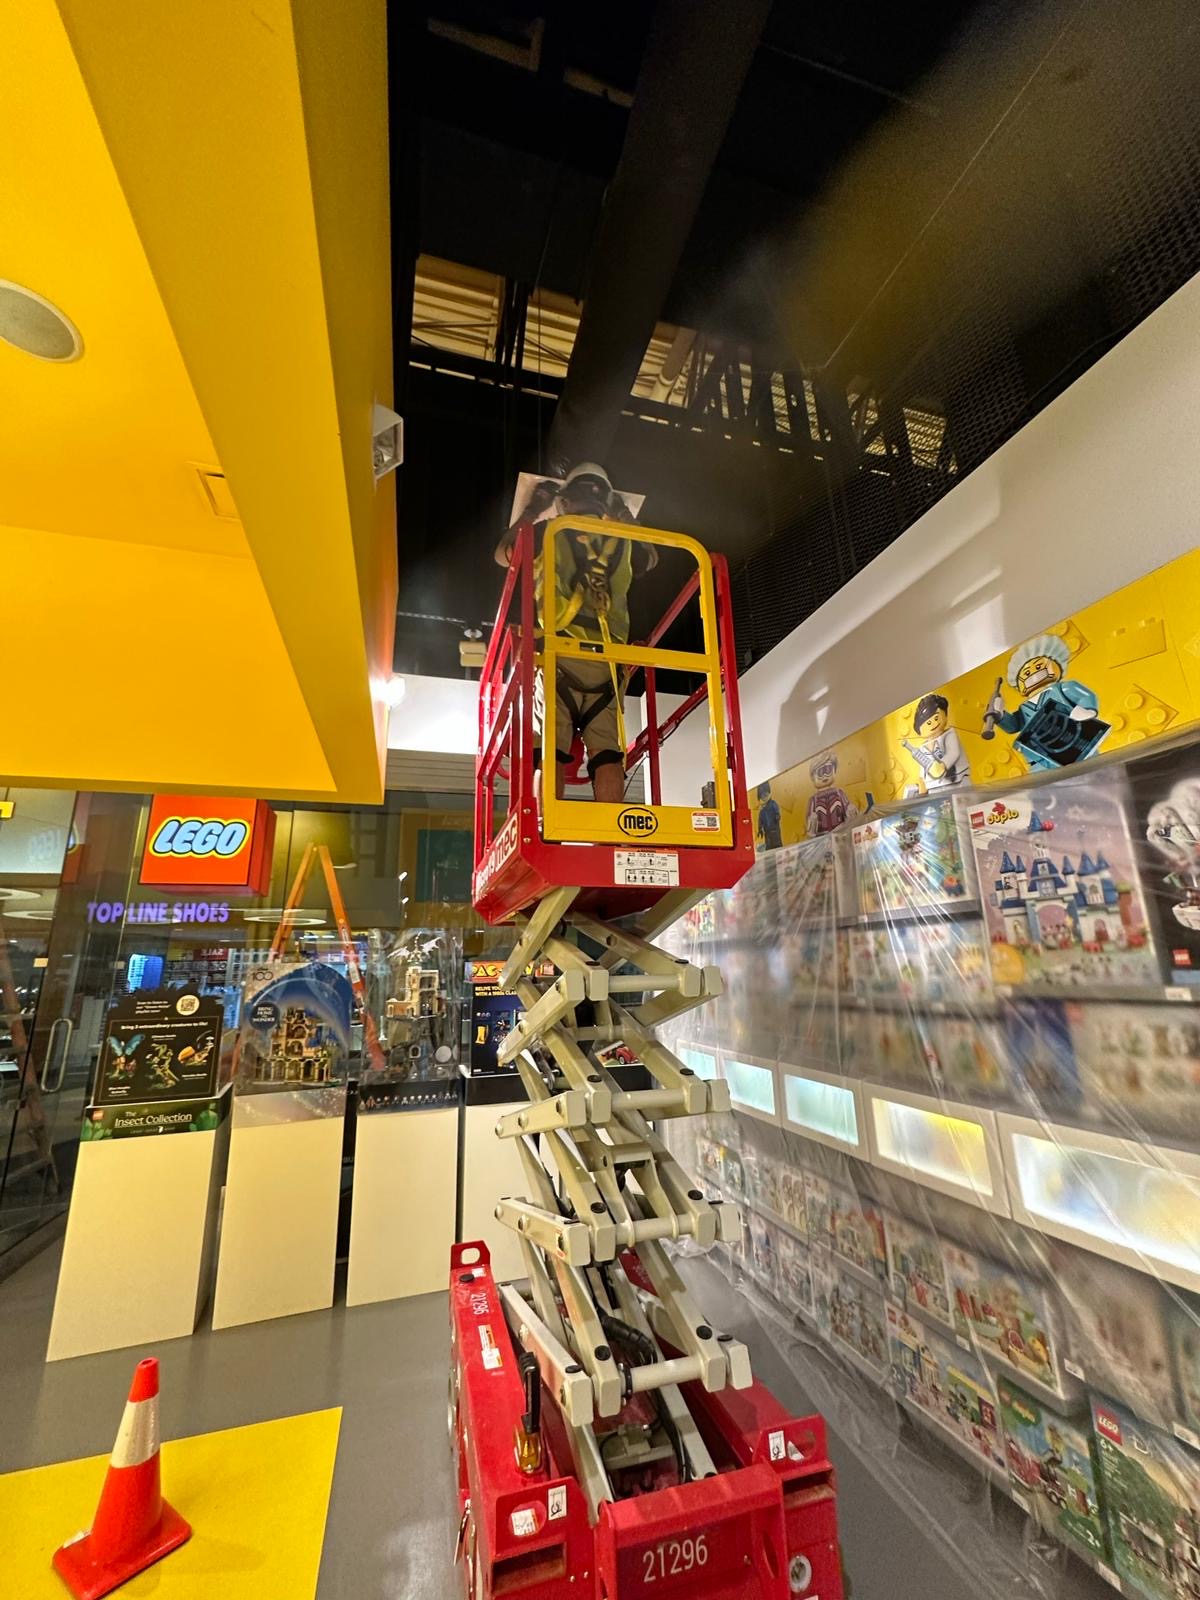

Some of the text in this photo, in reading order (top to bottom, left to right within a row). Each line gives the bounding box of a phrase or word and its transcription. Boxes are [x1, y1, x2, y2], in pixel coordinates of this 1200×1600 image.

[152, 818, 248, 856] LEGO
[86, 902, 230, 923] TOP LINE SHOES
[114, 1112, 193, 1128] Insect Collection
[1098, 1415, 1119, 1434] LEGO
[643, 1535, 708, 1583] 21296
